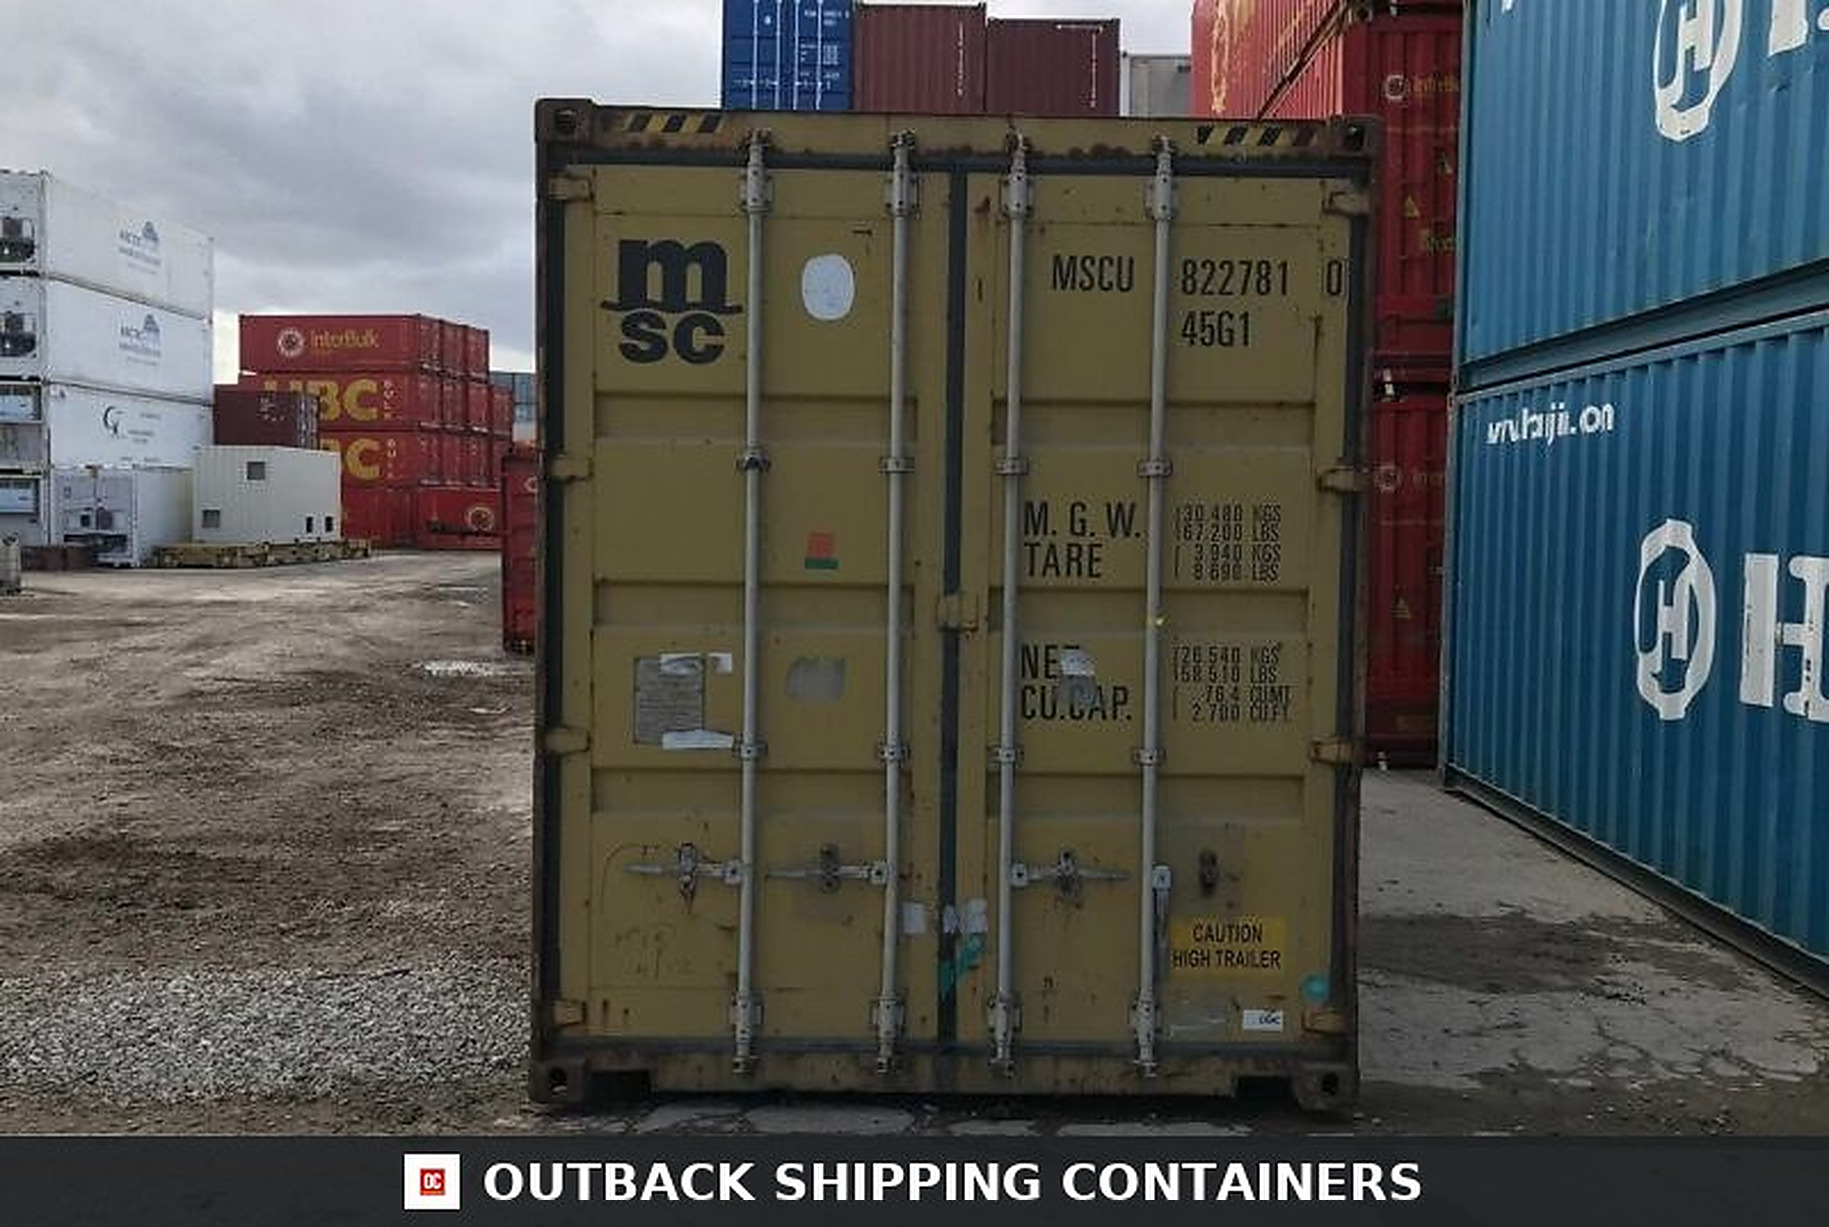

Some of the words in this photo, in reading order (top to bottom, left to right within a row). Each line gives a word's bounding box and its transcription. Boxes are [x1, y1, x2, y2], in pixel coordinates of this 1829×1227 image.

[1052, 255, 1134, 293] MSCU
[1181, 259, 1288, 296] 822781
[1326, 260, 1343, 296] 0
[1181, 311, 1250, 346] 45G1
[1024, 543, 1103, 578] TARE
[1021, 643, 1080, 680] NE
[1193, 923, 1263, 944] CAUTION
[1173, 950, 1211, 969] HIGH
[1216, 950, 1281, 970] TRAILER
